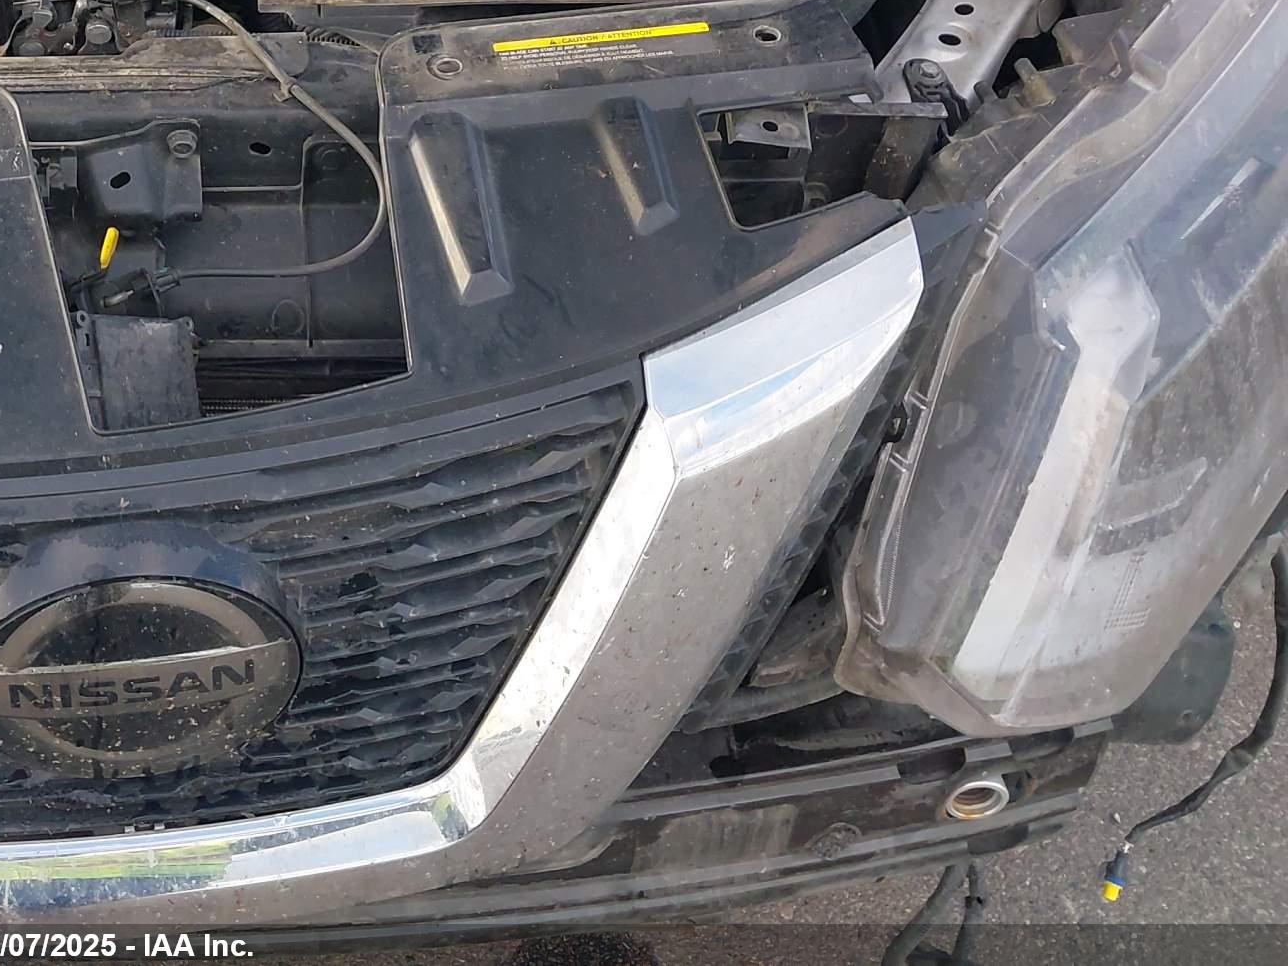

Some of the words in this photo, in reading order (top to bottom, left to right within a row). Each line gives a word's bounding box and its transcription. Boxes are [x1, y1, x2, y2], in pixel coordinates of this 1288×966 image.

[562, 35, 599, 44] CAUTION
[607, 30, 652, 39] ATTENTION
[8, 658, 255, 709] NISSAN
